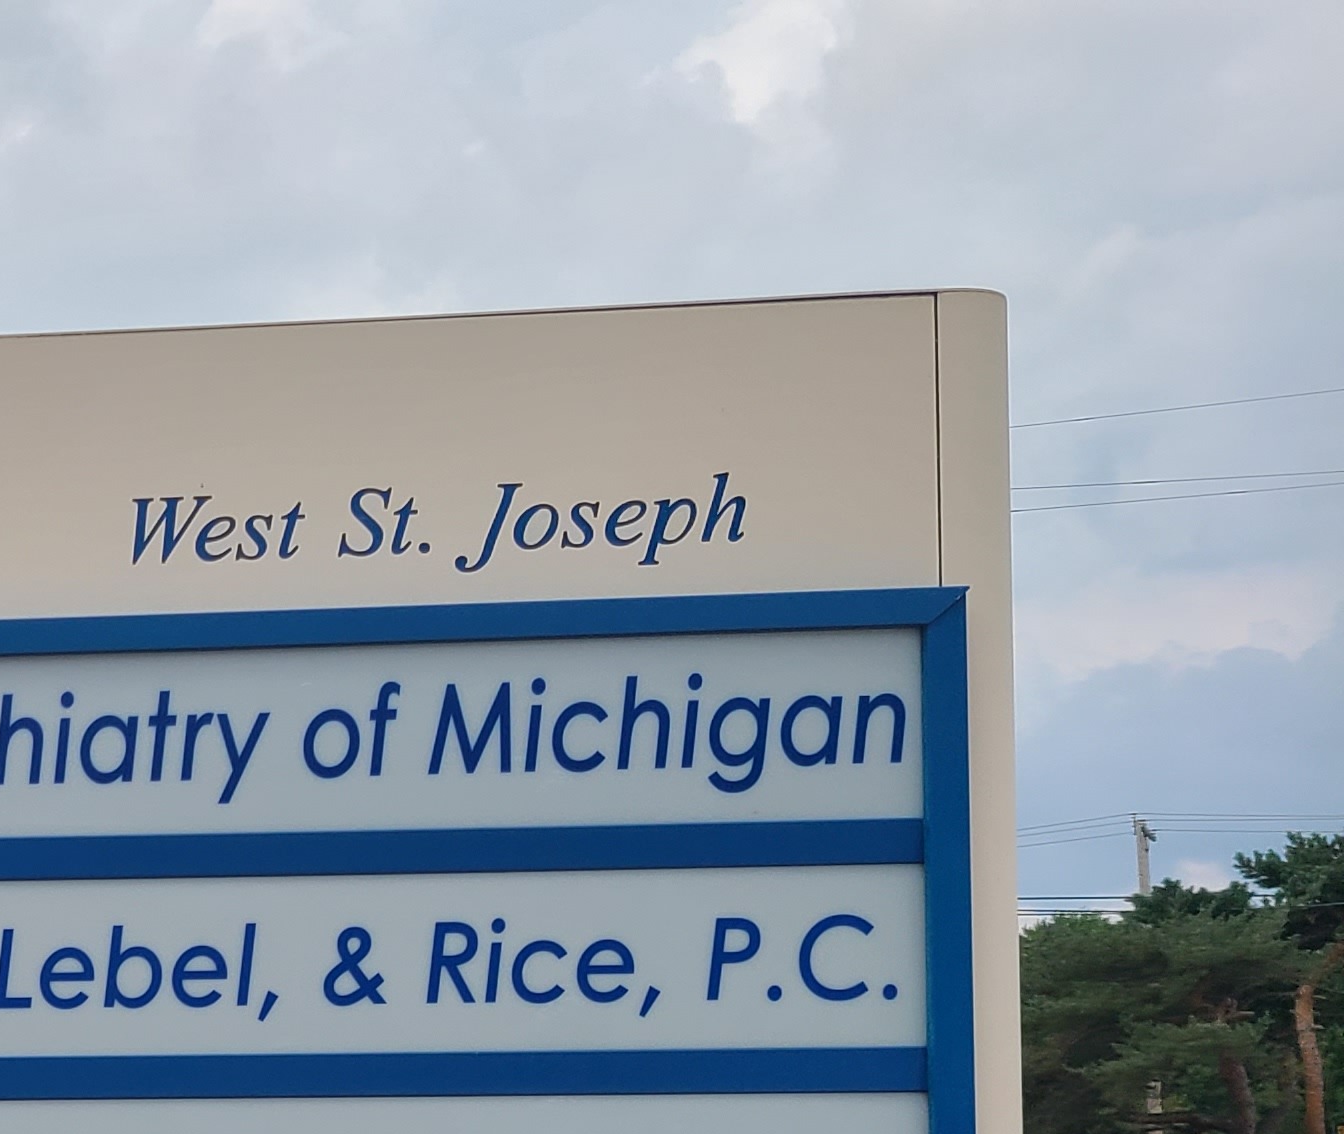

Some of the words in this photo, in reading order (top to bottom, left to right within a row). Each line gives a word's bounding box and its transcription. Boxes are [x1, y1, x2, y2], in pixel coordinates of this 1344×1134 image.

[130, 494, 304, 564] West
[339, 490, 429, 556] St.
[455, 471, 749, 572] Joseph
[302, 680, 402, 781] of
[426, 672, 909, 795] Michigan
[322, 925, 388, 1008] &
[425, 916, 662, 1019] Rice,
[705, 913, 899, 1003] P.C.
